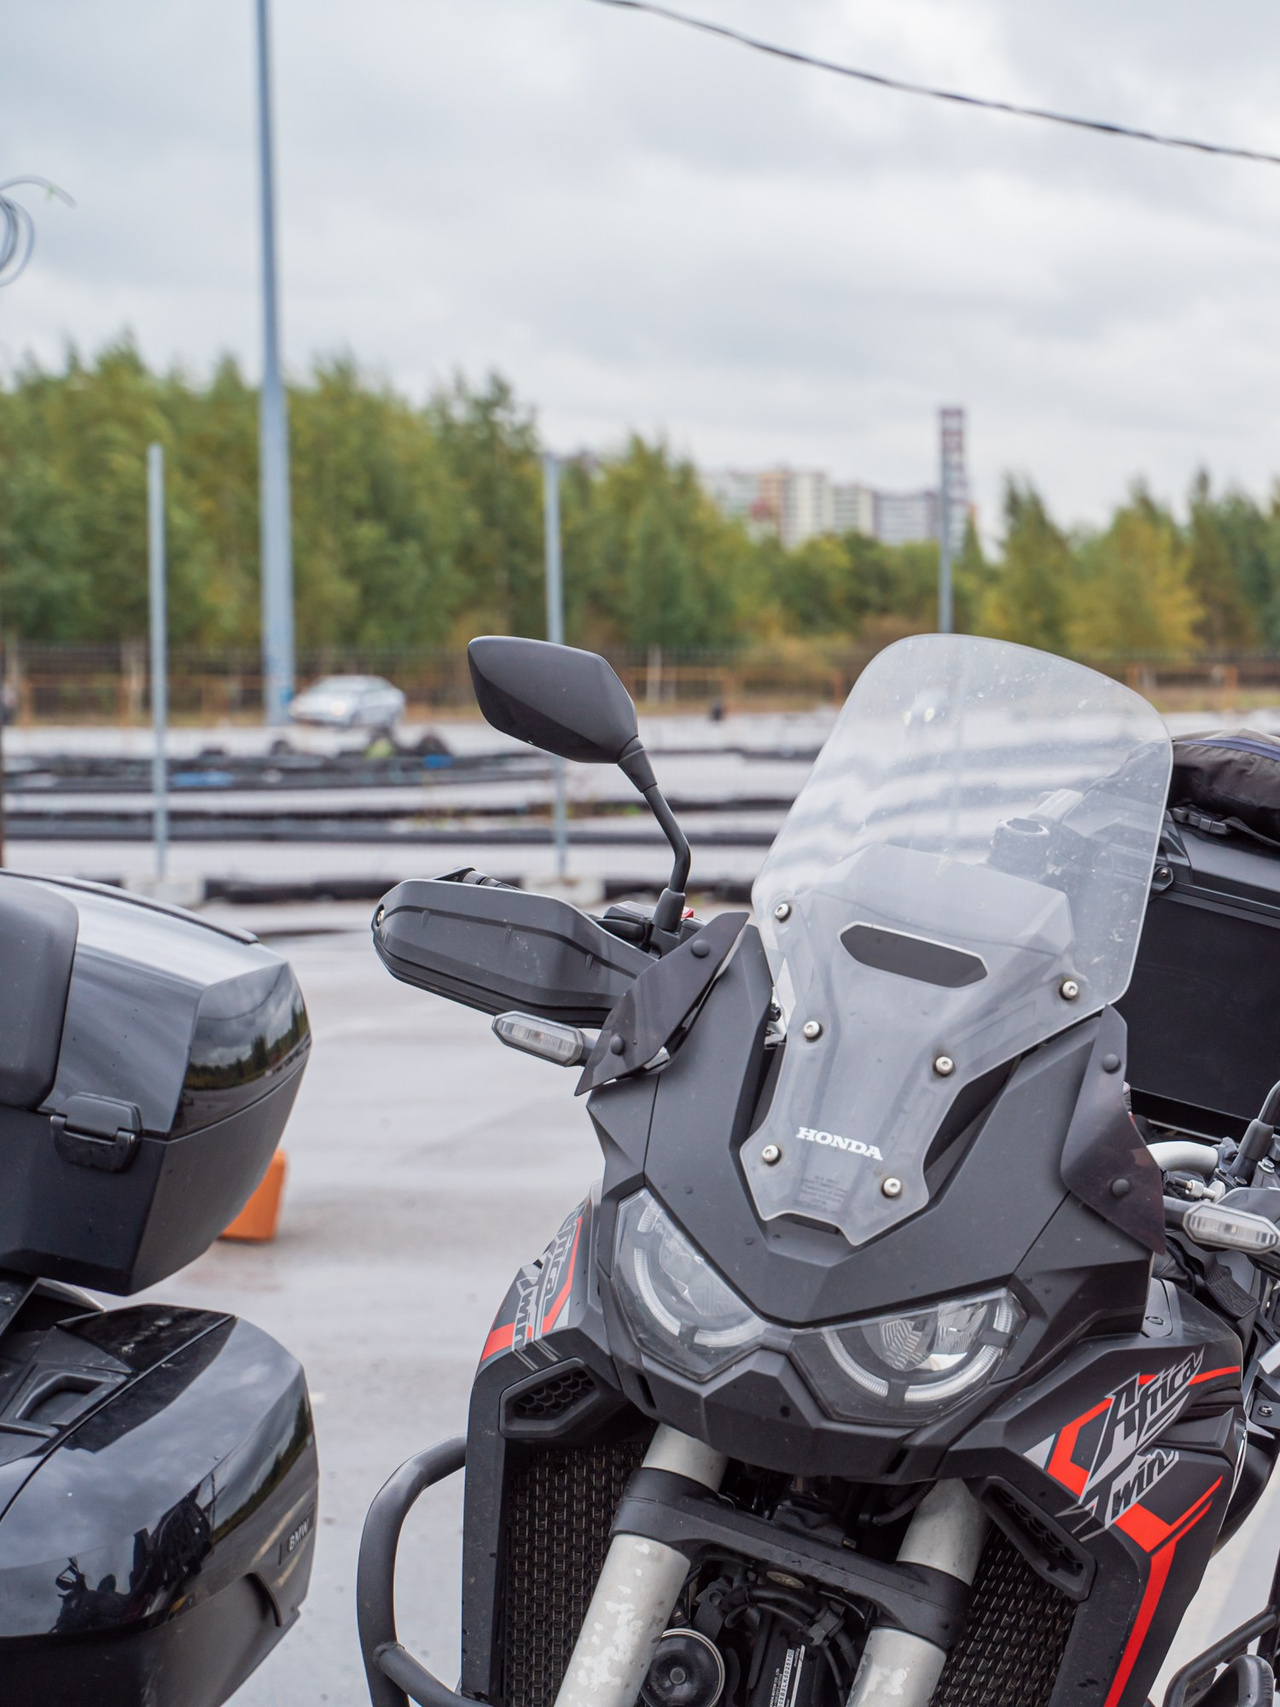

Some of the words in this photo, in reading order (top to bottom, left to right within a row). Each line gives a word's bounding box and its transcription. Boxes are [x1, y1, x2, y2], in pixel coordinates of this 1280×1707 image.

[796, 1126, 883, 1161] HONDA
[1083, 1344, 1204, 1492] Africa
[289, 1517, 310, 1552] BMW
